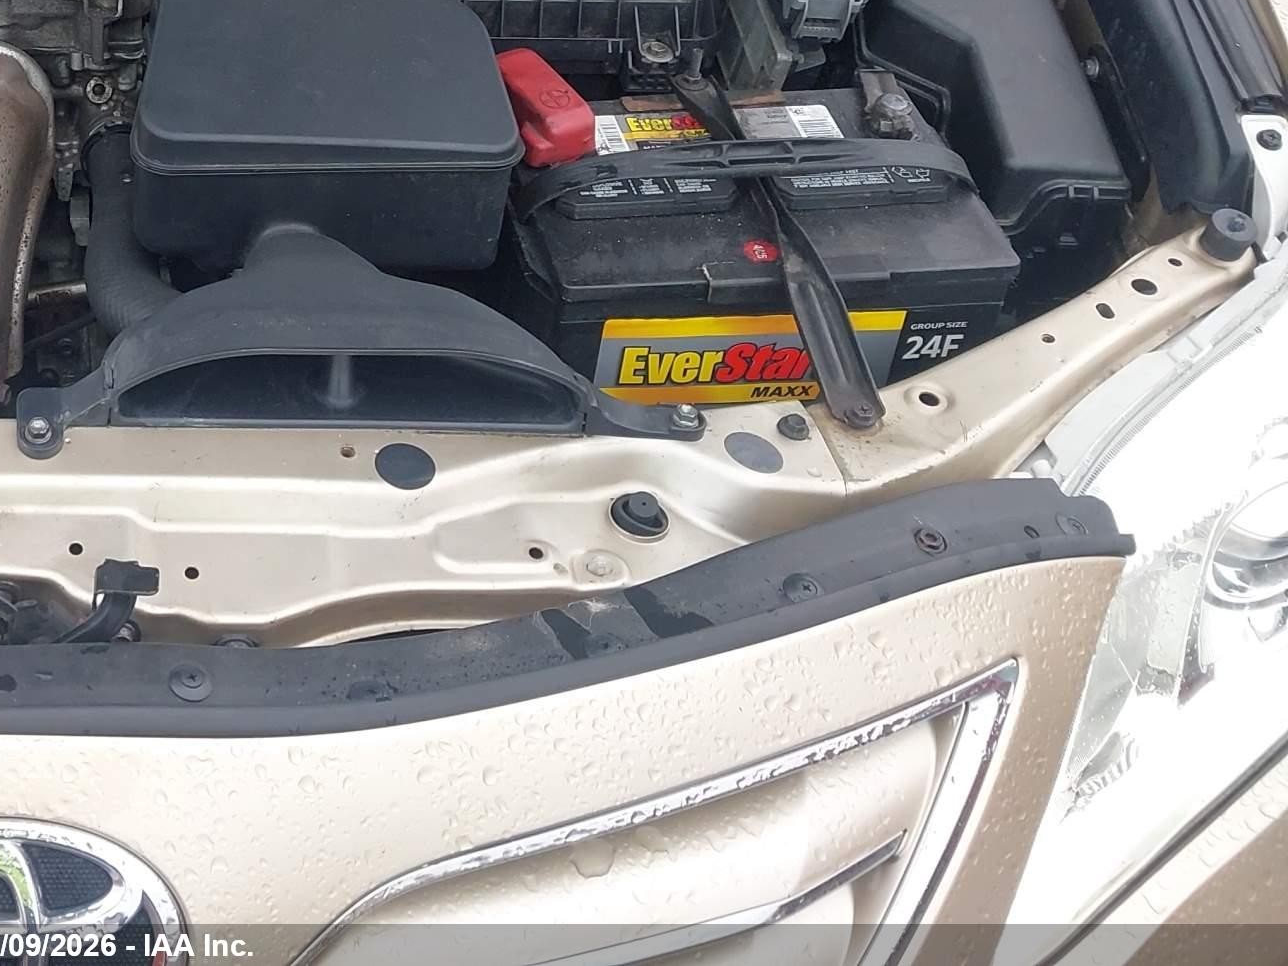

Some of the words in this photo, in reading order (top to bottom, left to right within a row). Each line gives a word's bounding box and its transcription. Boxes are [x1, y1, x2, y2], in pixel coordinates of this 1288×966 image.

[910, 322, 945, 330] GROUP
[946, 321, 969, 329] SIZE
[902, 334, 965, 359] 24F
[750, 385, 814, 398] MAXX
